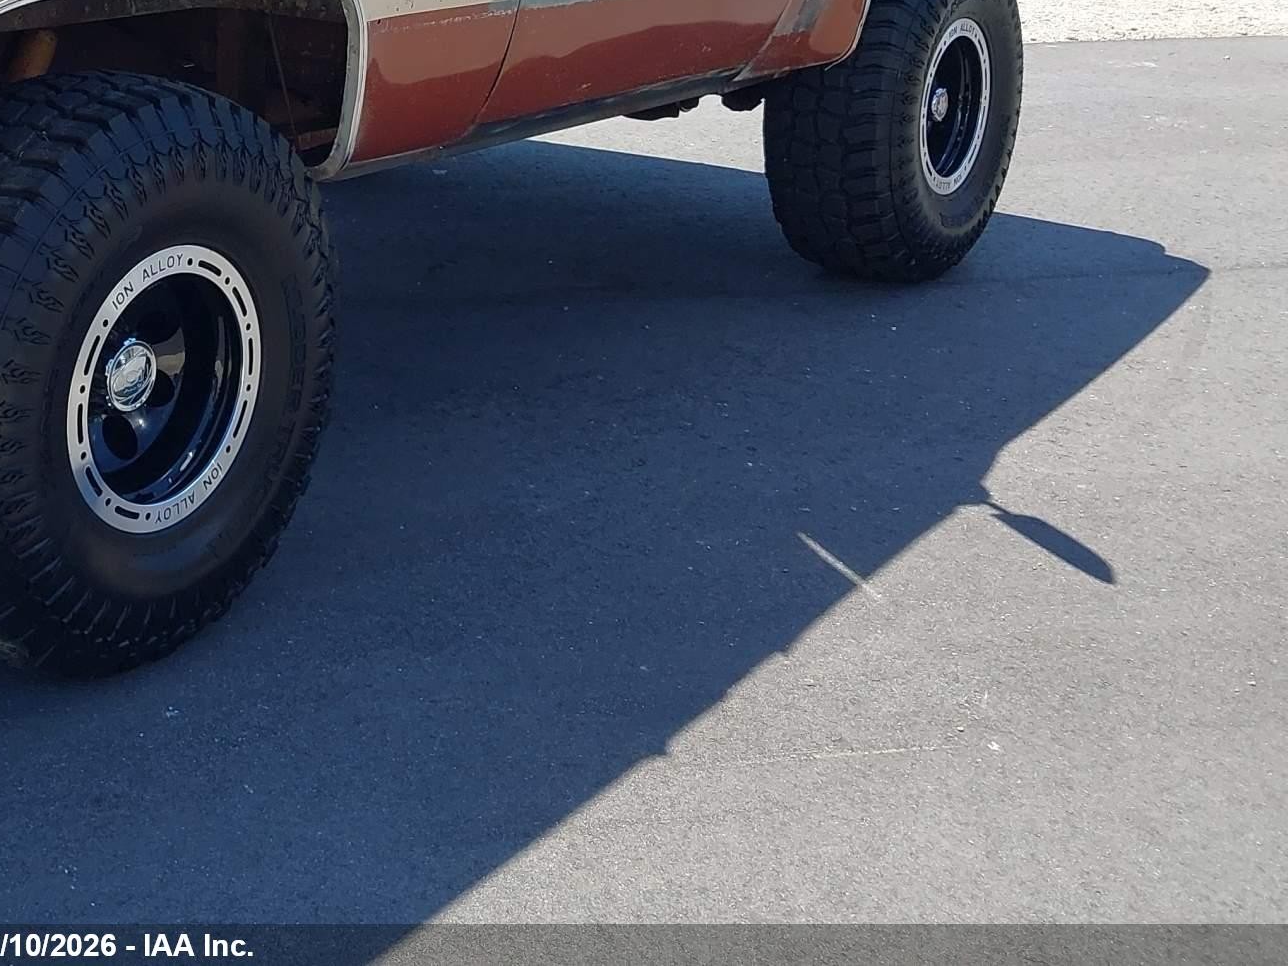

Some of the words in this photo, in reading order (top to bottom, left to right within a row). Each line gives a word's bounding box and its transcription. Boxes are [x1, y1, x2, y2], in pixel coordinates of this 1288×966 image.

[112, 281, 134, 310] ION
[142, 253, 184, 282] ALLOY
[202, 462, 223, 490] ION
[154, 490, 195, 524] ALLOY
